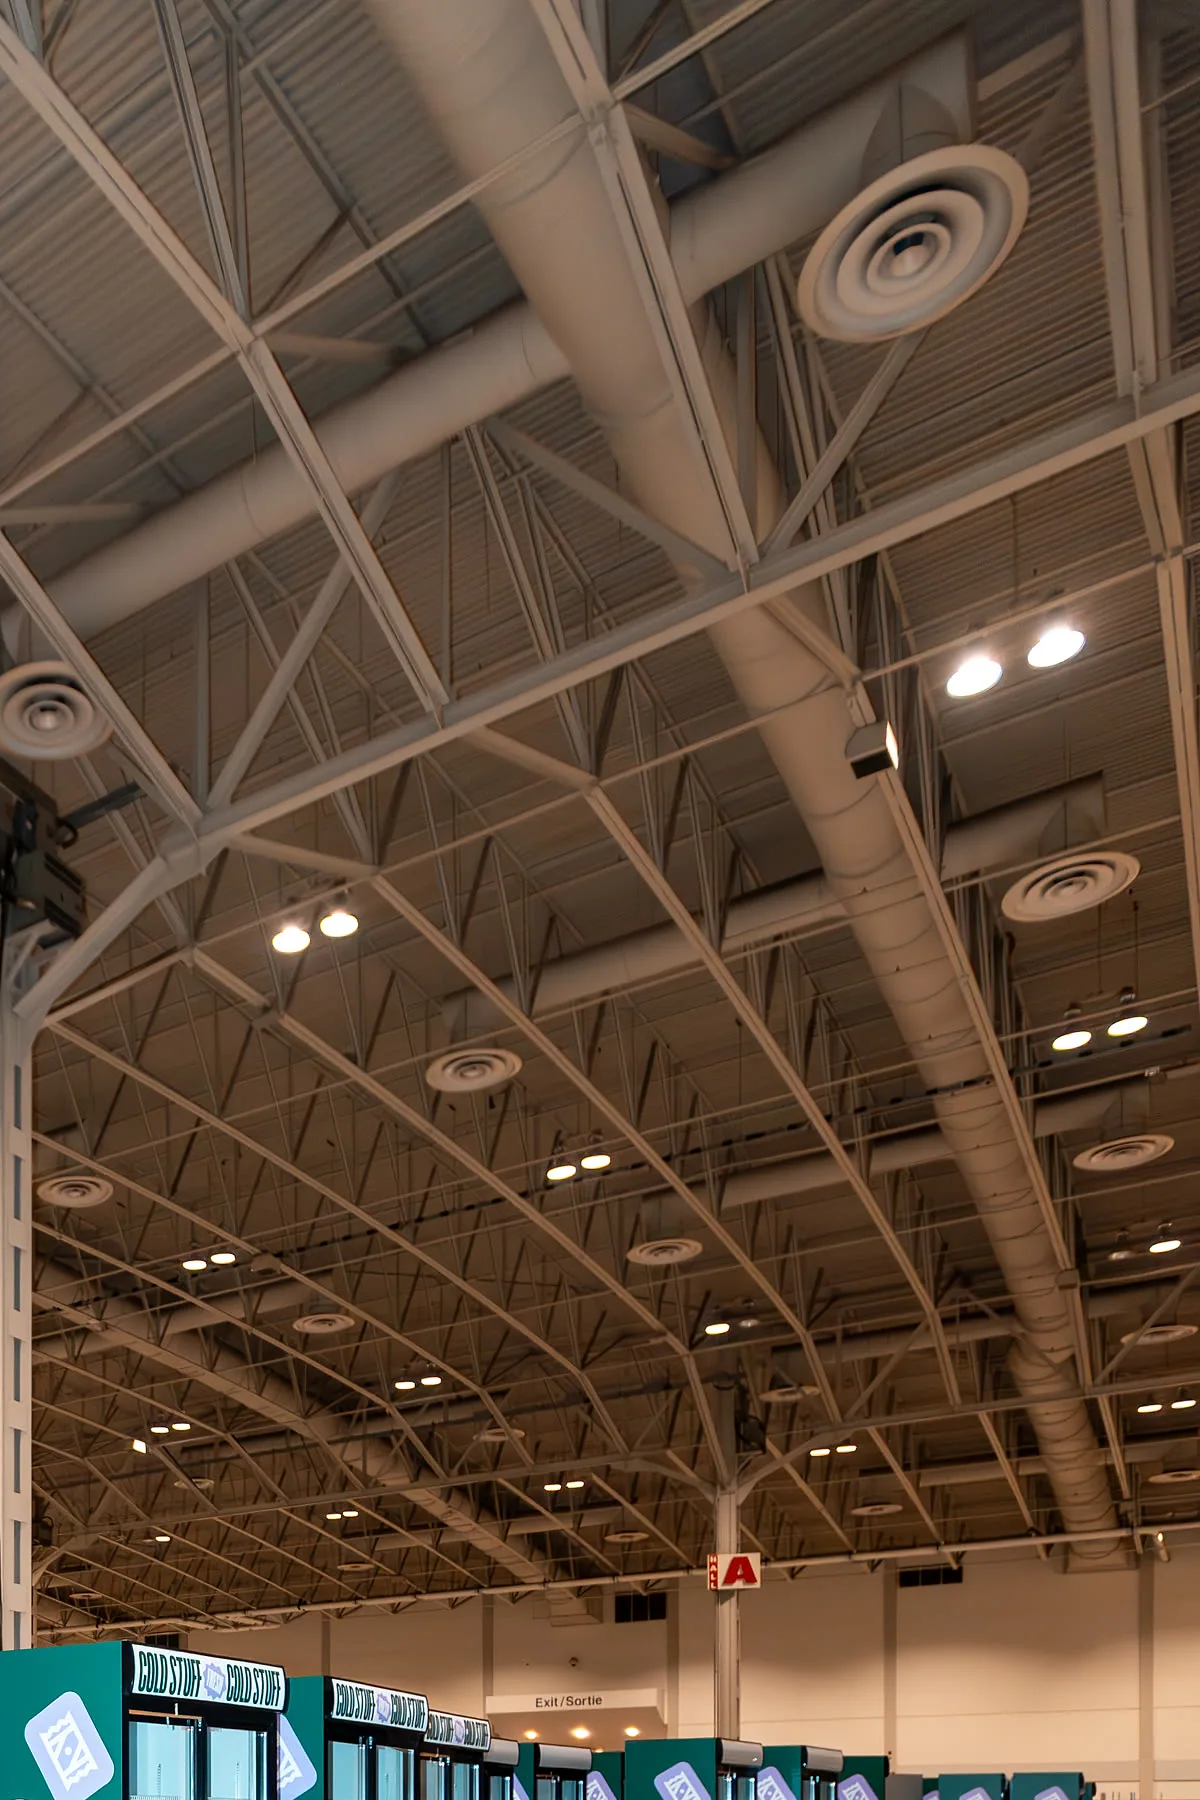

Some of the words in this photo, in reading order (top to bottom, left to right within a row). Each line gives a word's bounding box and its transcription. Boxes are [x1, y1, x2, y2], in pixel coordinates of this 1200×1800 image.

[710, 1555, 718, 1589] HALL
[722, 1556, 758, 1586] A
[138, 1650, 168, 1693] COLD
[169, 1655, 202, 1698] STUFF
[226, 1663, 251, 1703] COLD
[253, 1667, 281, 1707] STUFF
[336, 1683, 355, 1717] COLD
[355, 1686, 375, 1721] STUFF
[390, 1694, 407, 1725] COLD
[407, 1697, 426, 1729] STUFF
[427, 1713, 440, 1740] OLD
